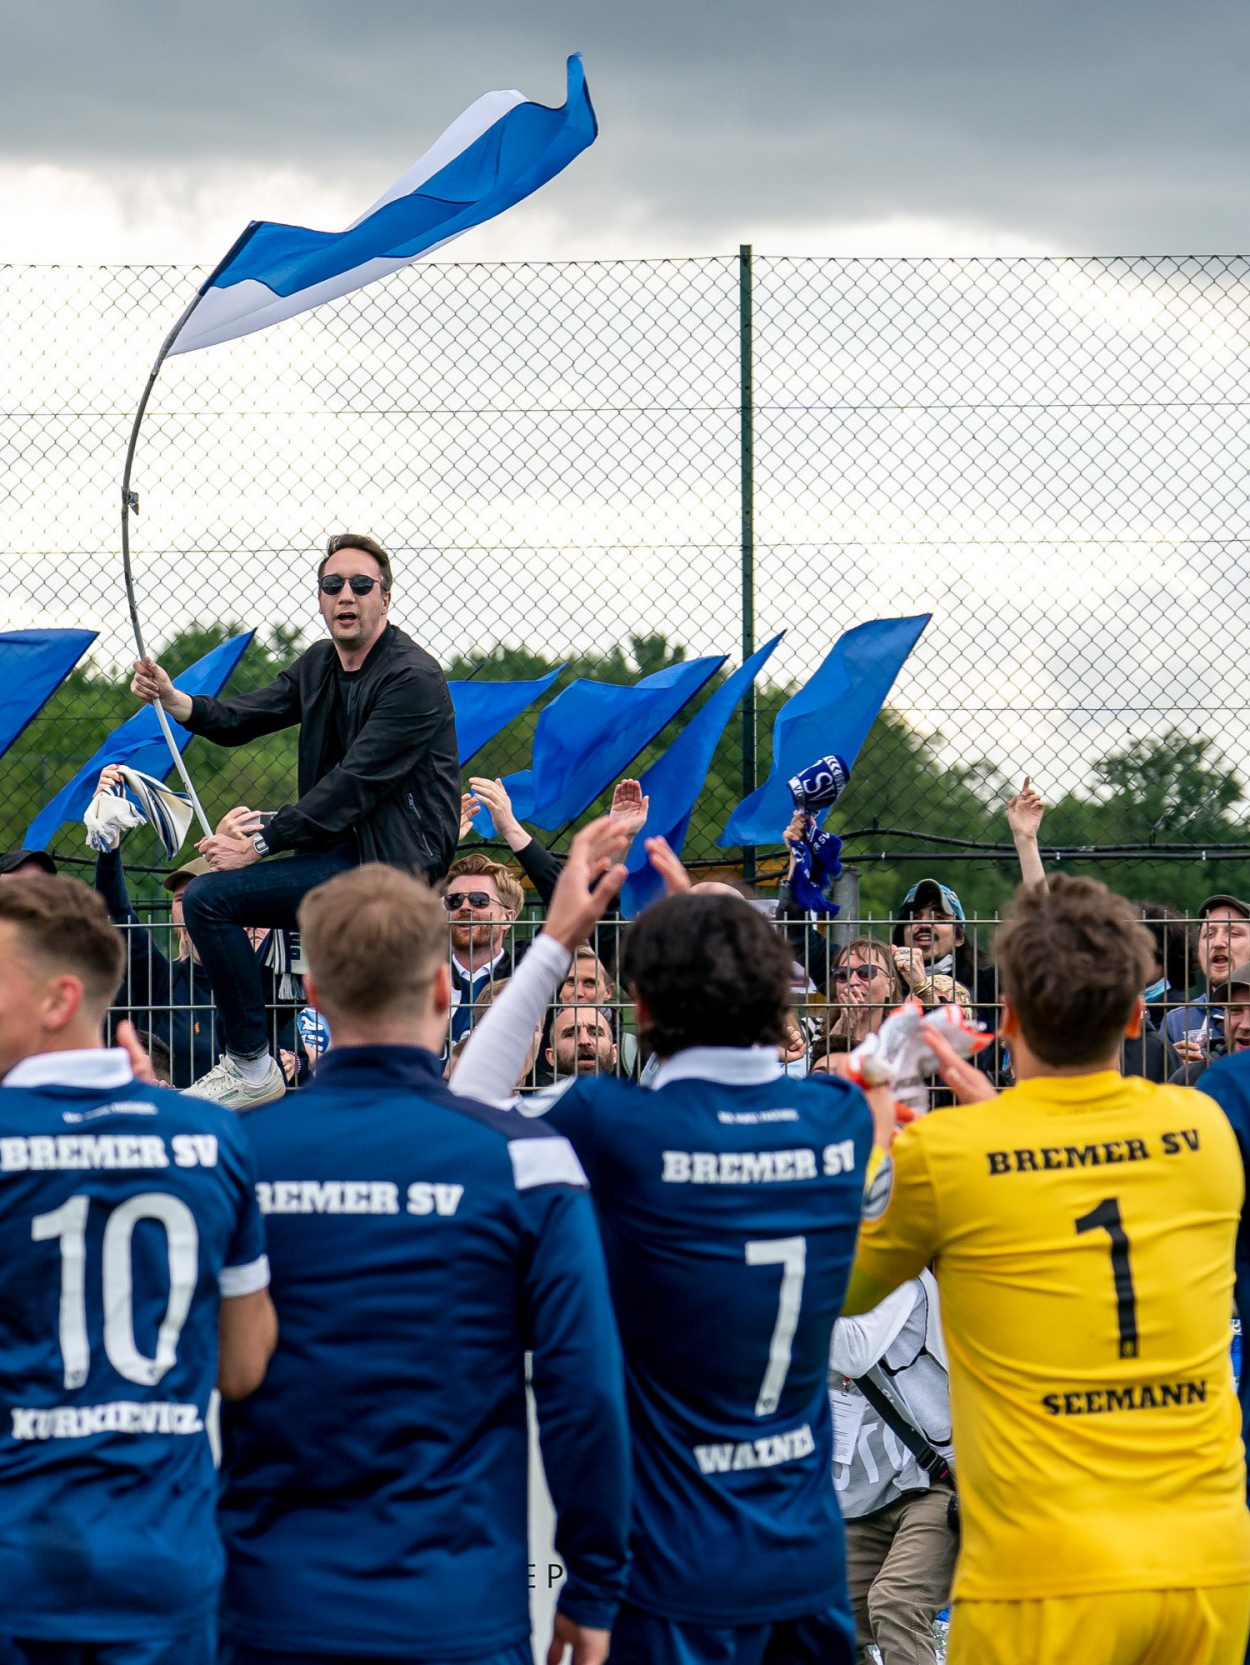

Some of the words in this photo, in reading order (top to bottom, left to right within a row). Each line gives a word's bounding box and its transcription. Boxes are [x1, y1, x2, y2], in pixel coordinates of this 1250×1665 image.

[172, 1134, 218, 1168] SV
[662, 1148, 818, 1184] BREMER
[987, 1138, 1151, 1175] BREMER
[1161, 1129, 1202, 1155] SV
[406, 1181, 464, 1216] SV
[31, 1192, 199, 1390] 10
[1075, 1197, 1139, 1359] 1
[745, 1236, 806, 1417] 7
[1043, 1380, 1208, 1416] SEEMANN
